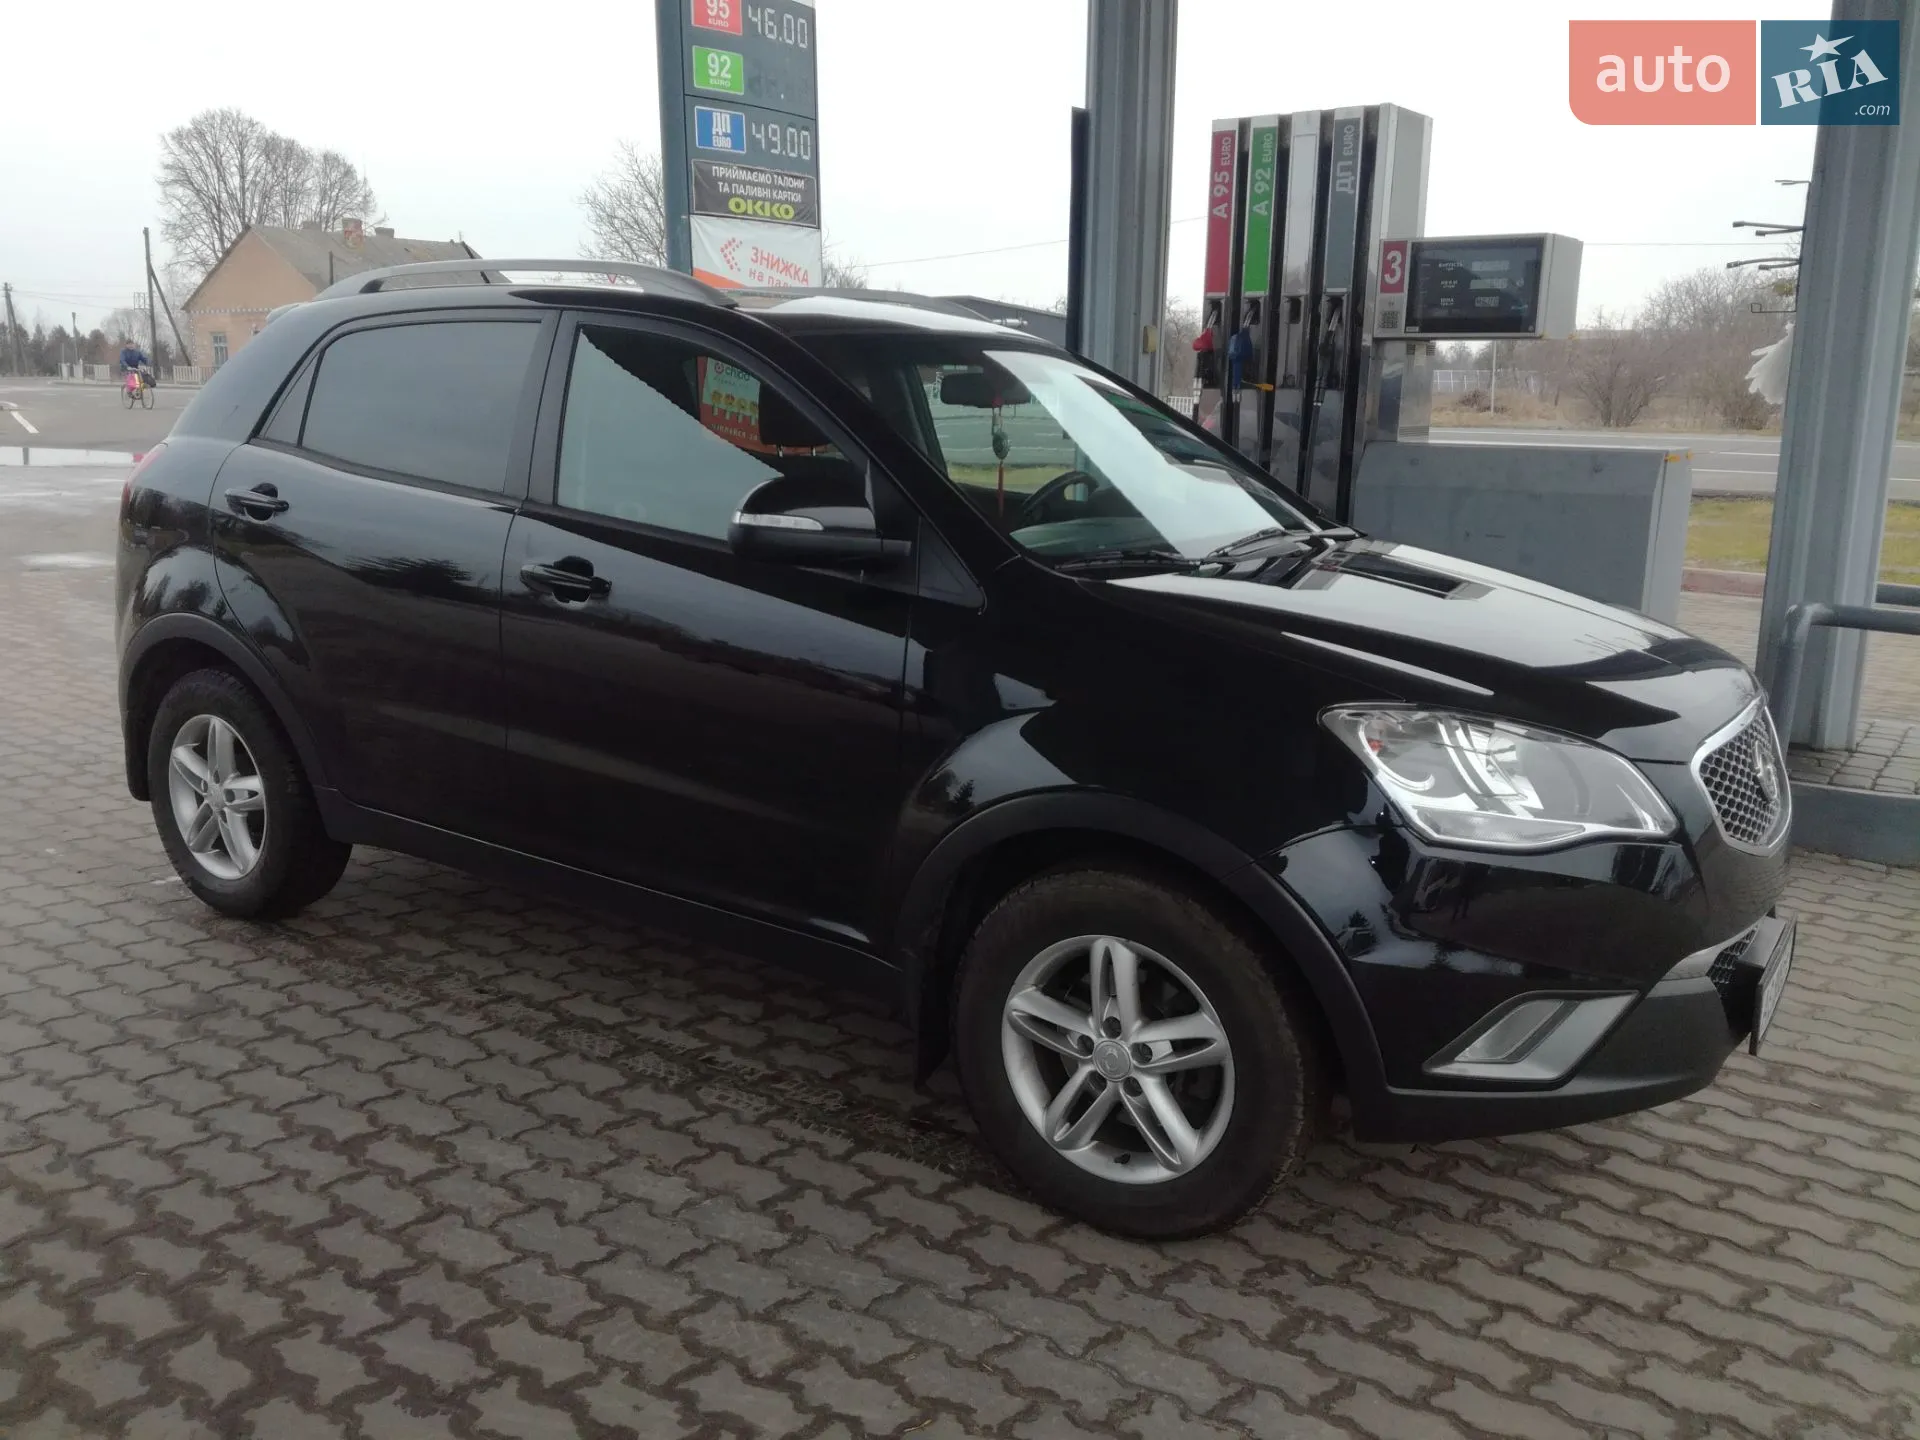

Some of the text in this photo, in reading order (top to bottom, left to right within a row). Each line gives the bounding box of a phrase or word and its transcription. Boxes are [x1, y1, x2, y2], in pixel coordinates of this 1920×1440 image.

[707, 0, 730, 19] 95
[708, 18, 729, 28] EURO
[748, 4, 808, 48] 46.00
[707, 52, 731, 79] 92
[709, 78, 731, 88] EURO
[712, 112, 731, 136] ДП
[712, 135, 732, 149] EURO
[752, 121, 810, 160] 49.00
[1221, 136, 1232, 166] EURO
[1263, 133, 1273, 162] EURO
[1336, 124, 1355, 194] ДП EURO
[712, 166, 805, 190] ПРИЙМАЄМО ТАЛОНИ
[1214, 171, 1230, 197] 95
[1255, 167, 1272, 194] 92
[718, 181, 802, 203] ТА ПАЛИВНІ КАРТКИ
[749, 267, 764, 282] на
[751, 246, 809, 286] ЗНИЖКА
[1383, 250, 1403, 285] 3
